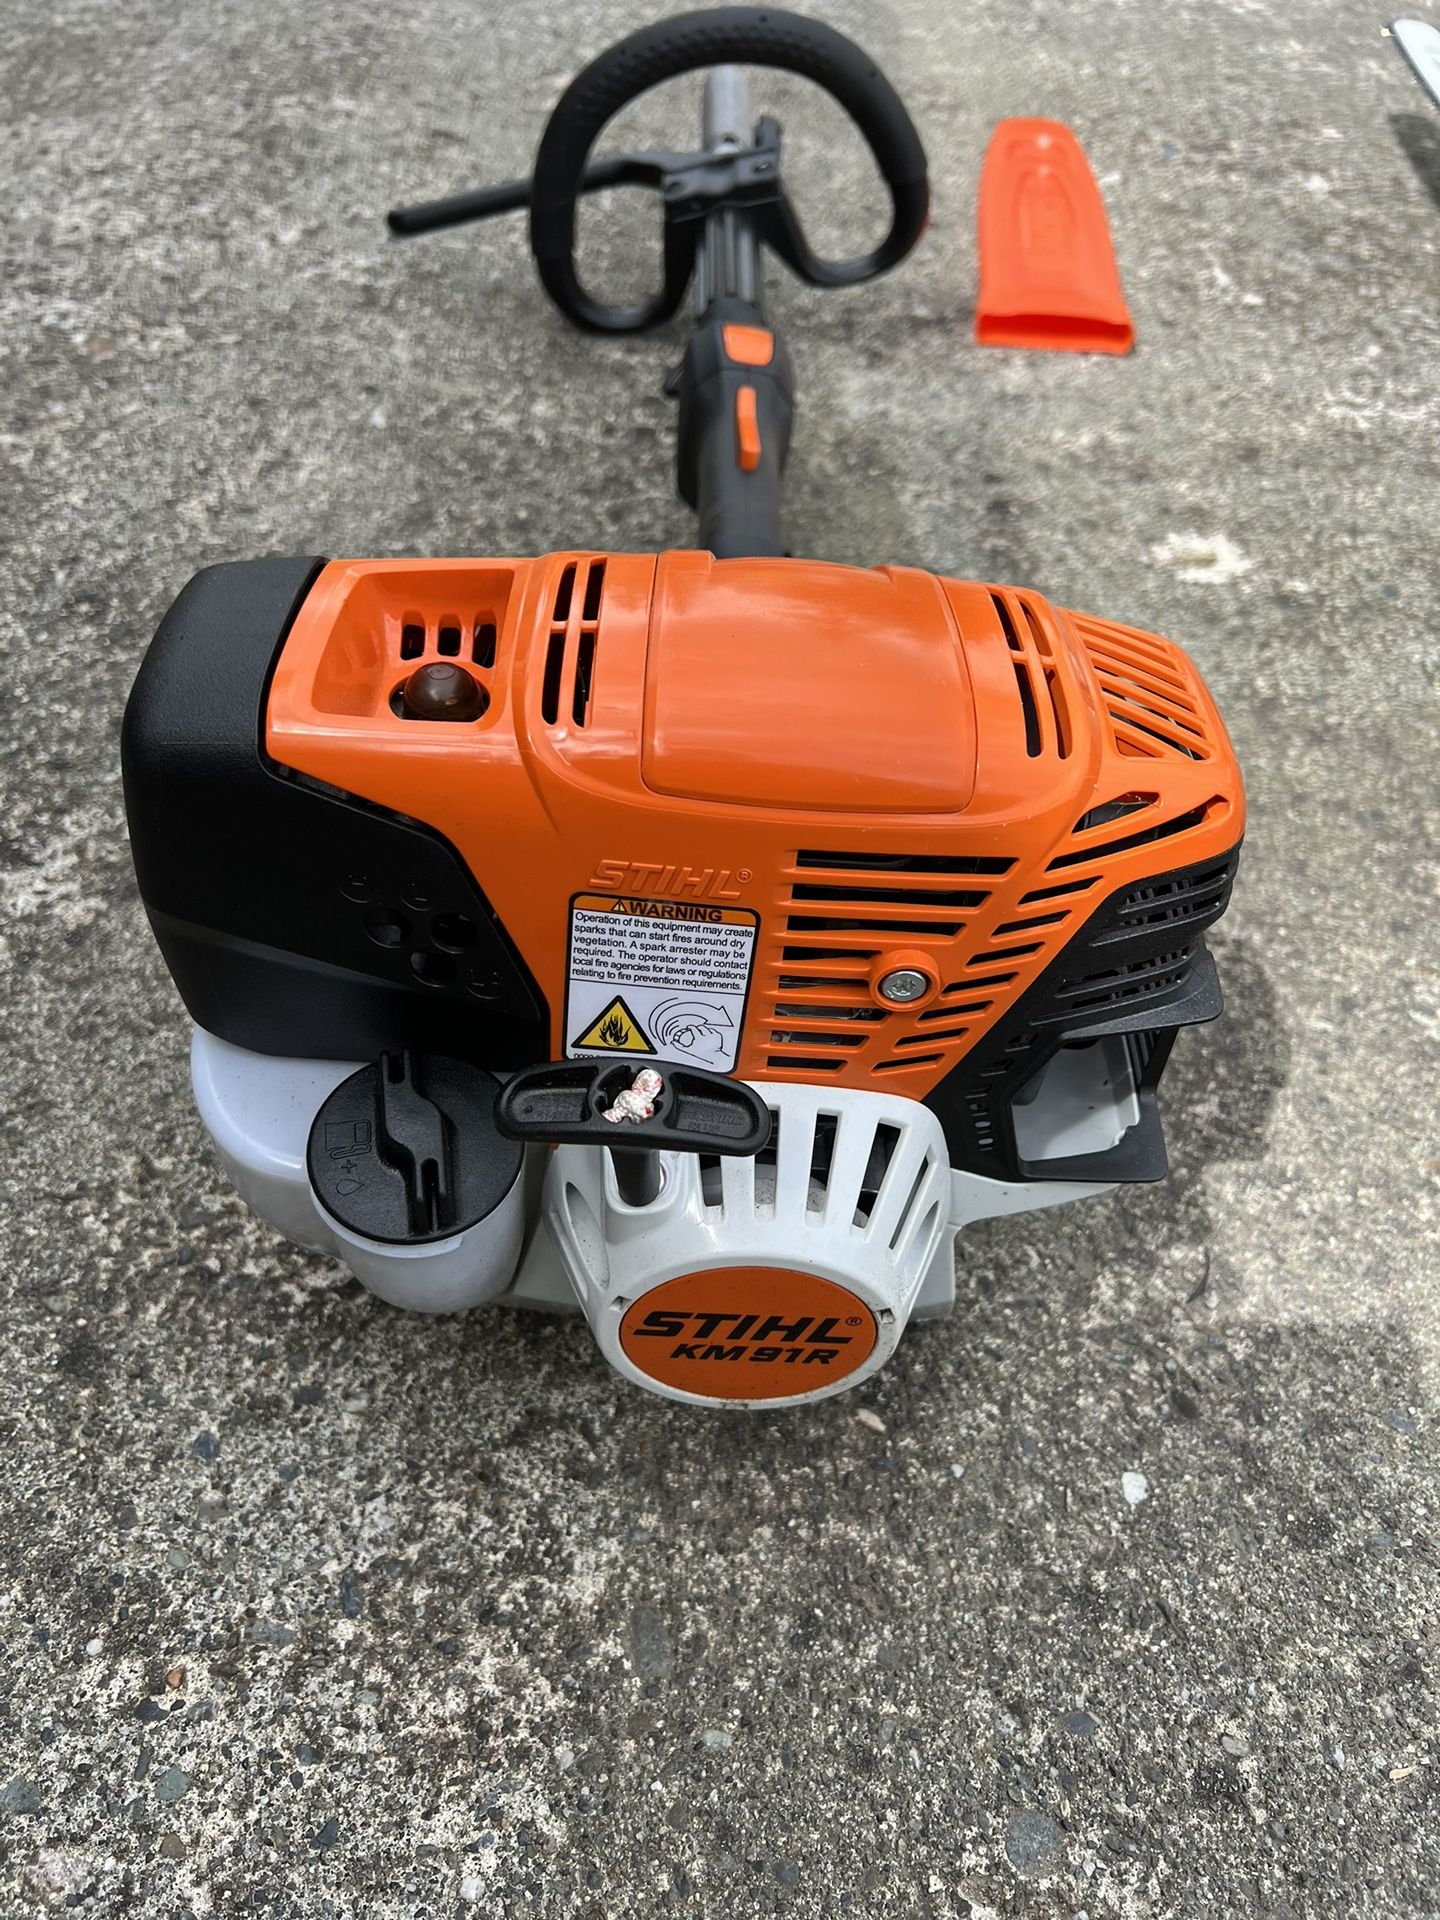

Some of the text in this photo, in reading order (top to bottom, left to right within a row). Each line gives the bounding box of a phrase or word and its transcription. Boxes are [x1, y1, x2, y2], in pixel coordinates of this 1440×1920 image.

[629, 901, 723, 922] WARNING
[575, 912, 754, 938] Operation of this equipment may create
[573, 936, 746, 960] vegetation. A spark arrester may be
[574, 925, 746, 950] sparks that can start fires around dry
[572, 957, 594, 967] local
[595, 959, 609, 968] fire
[610, 962, 651, 972] agencies
[652, 964, 665, 973] for
[665, 966, 686, 975] laws
[698, 969, 747, 981] regulations
[573, 947, 749, 970] required. The operator should contact
[571, 968, 743, 991] relating to fire prevention requirements.
[670, 1343, 840, 1365] KM 91R
